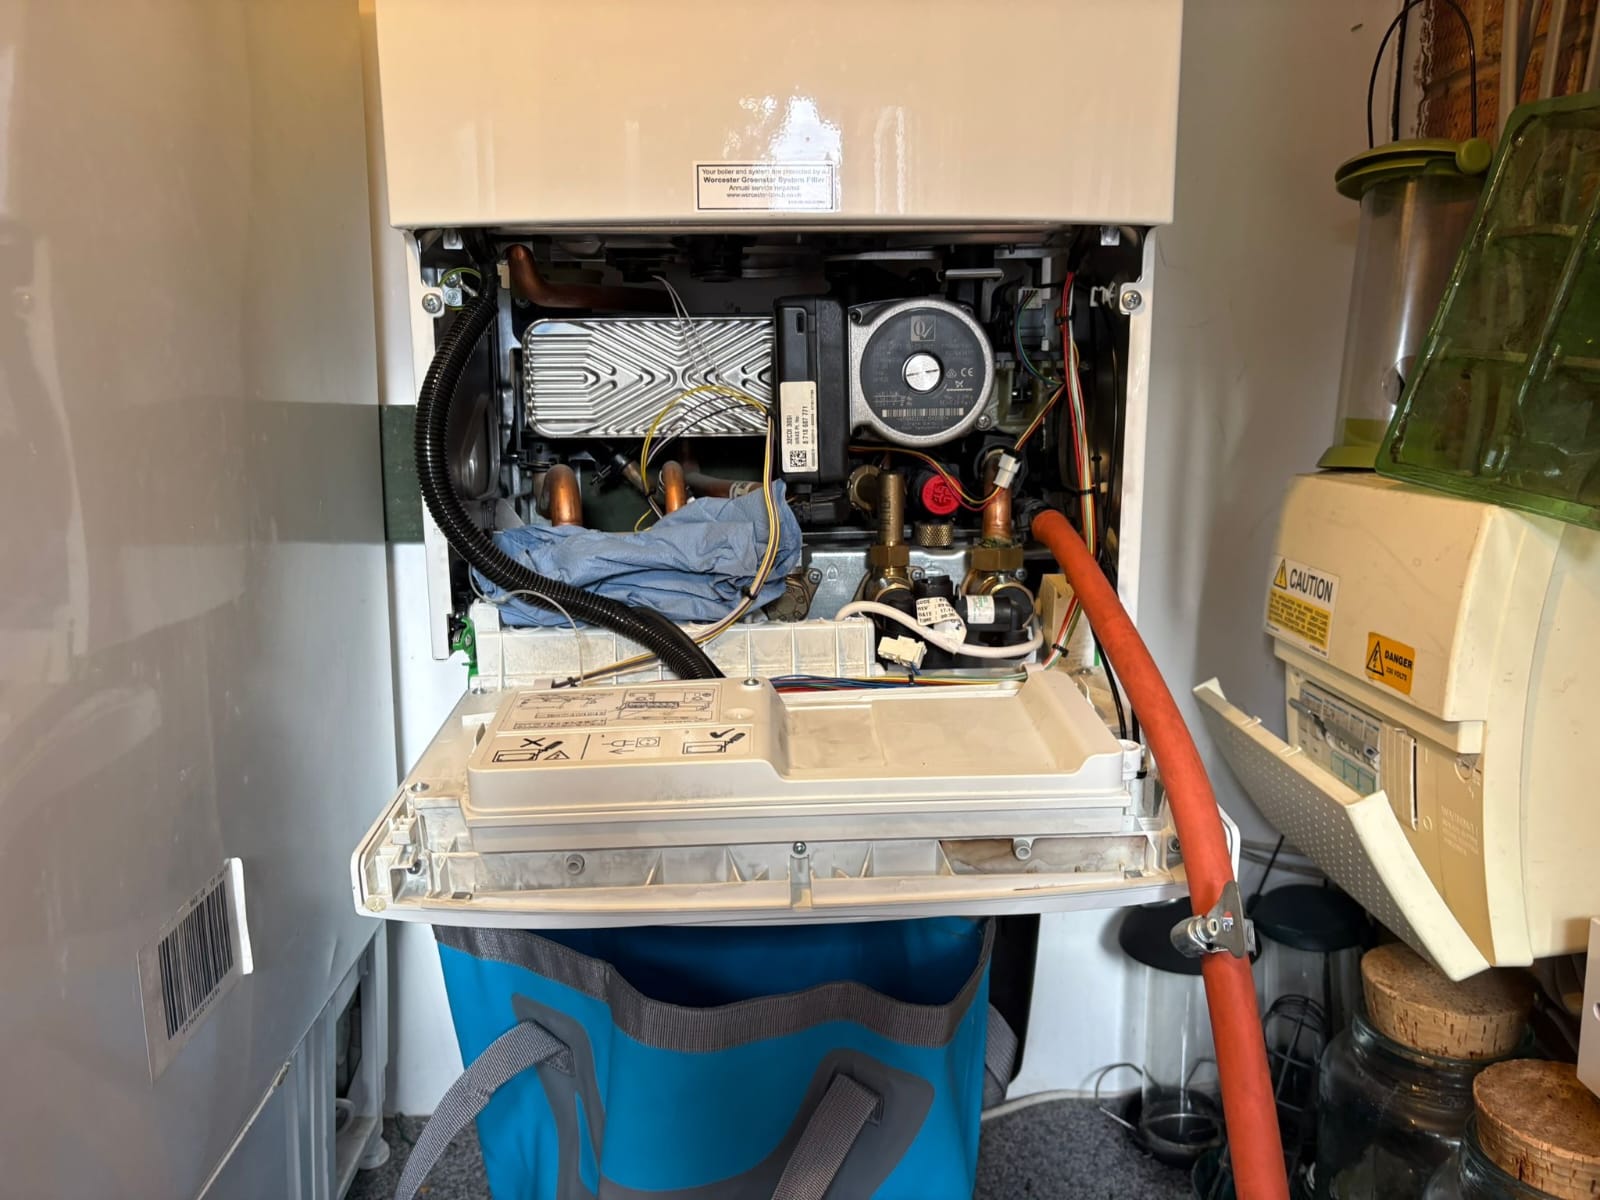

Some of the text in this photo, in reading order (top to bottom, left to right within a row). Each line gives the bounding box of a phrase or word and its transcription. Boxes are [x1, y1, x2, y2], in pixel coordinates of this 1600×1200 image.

[1289, 568, 1333, 603] CAUTION
[1385, 649, 1413, 669] DANGER
[1394, 670, 1408, 681] VOLTS
